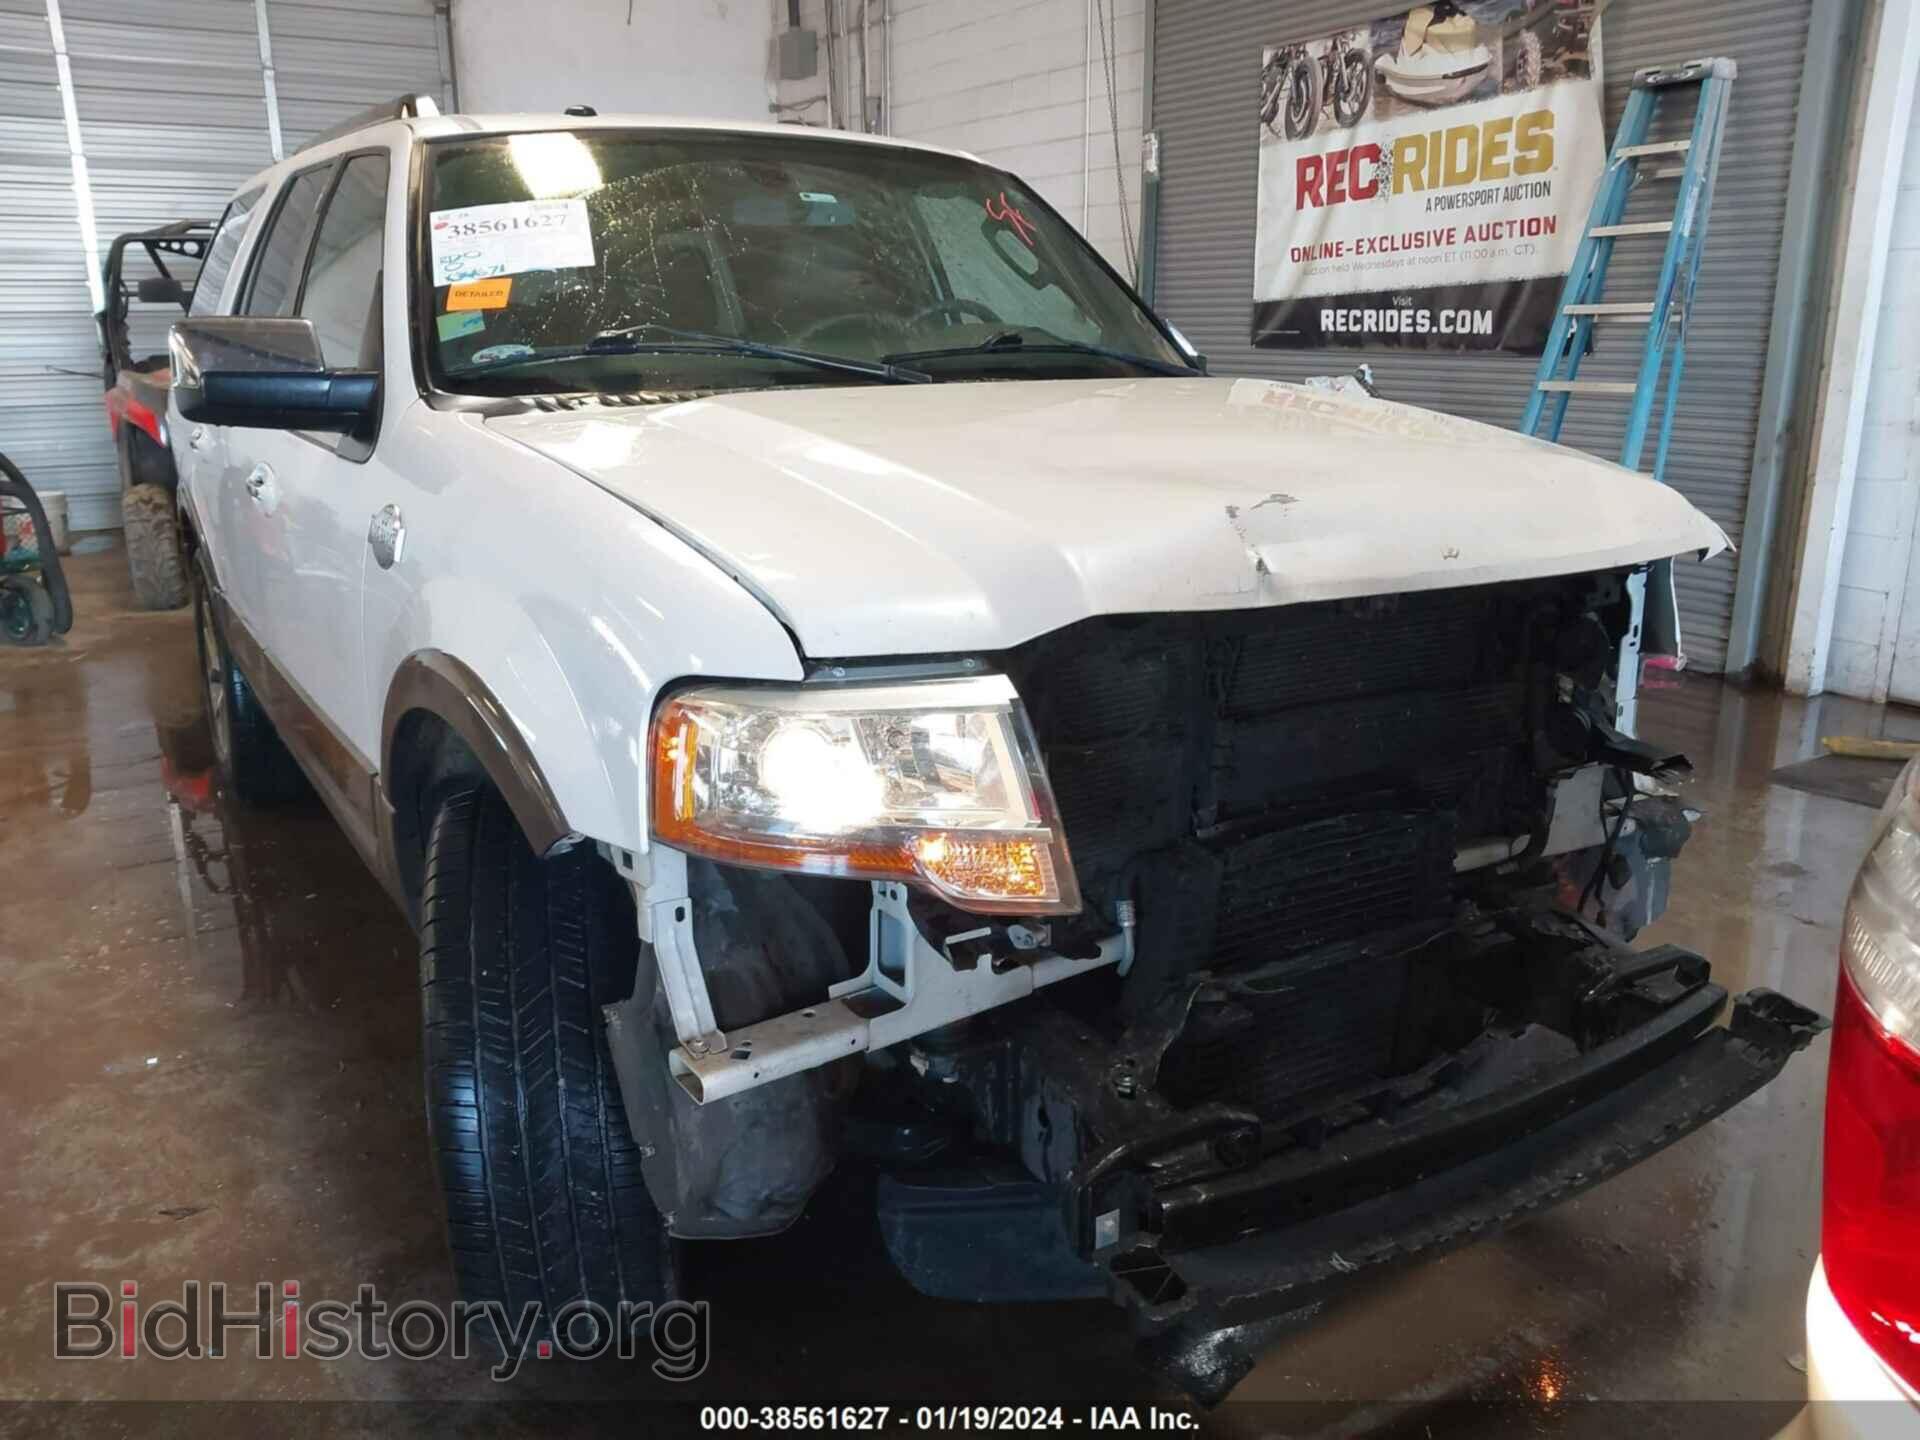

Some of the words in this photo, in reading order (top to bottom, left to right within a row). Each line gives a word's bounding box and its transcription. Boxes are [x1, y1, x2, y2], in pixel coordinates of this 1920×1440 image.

[1296, 142, 1382, 211] REC
[1391, 108, 1554, 195] RIDES
[1425, 198, 1433, 212] A
[1434, 189, 1500, 212] POWERSPORT
[1502, 180, 1552, 203] AUCTION
[448, 214, 568, 240] 38561627
[1291, 227, 1457, 263] ONLINE-EXCLUSIVE
[1464, 215, 1557, 244] AUCTION
[1392, 295, 1412, 306] Visit
[1320, 309, 1493, 334] RECRIDES.COM
